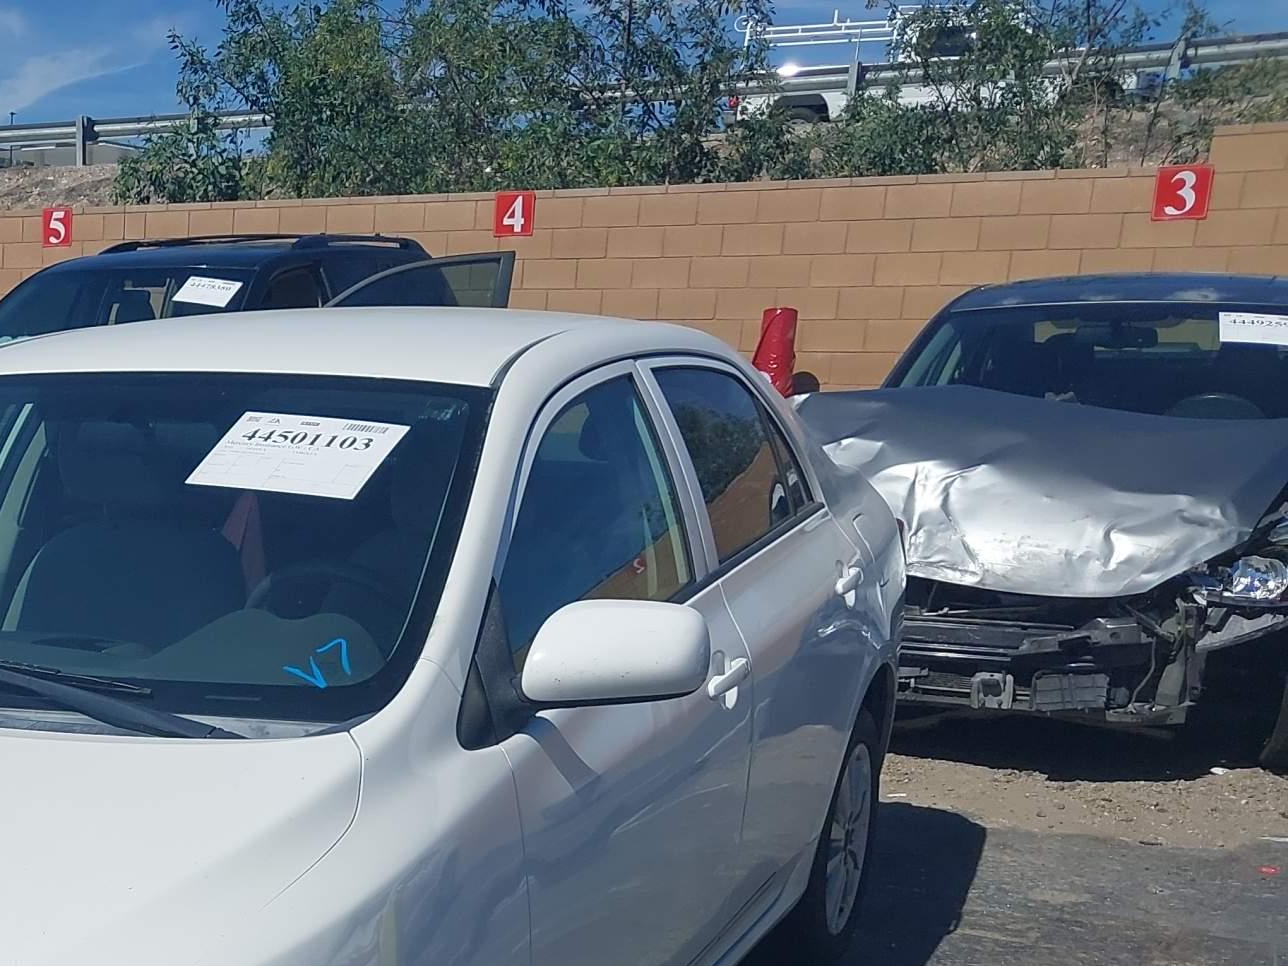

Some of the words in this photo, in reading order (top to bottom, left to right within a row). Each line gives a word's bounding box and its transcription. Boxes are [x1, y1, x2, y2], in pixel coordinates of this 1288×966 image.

[1164, 170, 1196, 215] 3
[49, 211, 65, 244] 5
[502, 195, 524, 232] 4
[242, 427, 374, 452] 44501103
